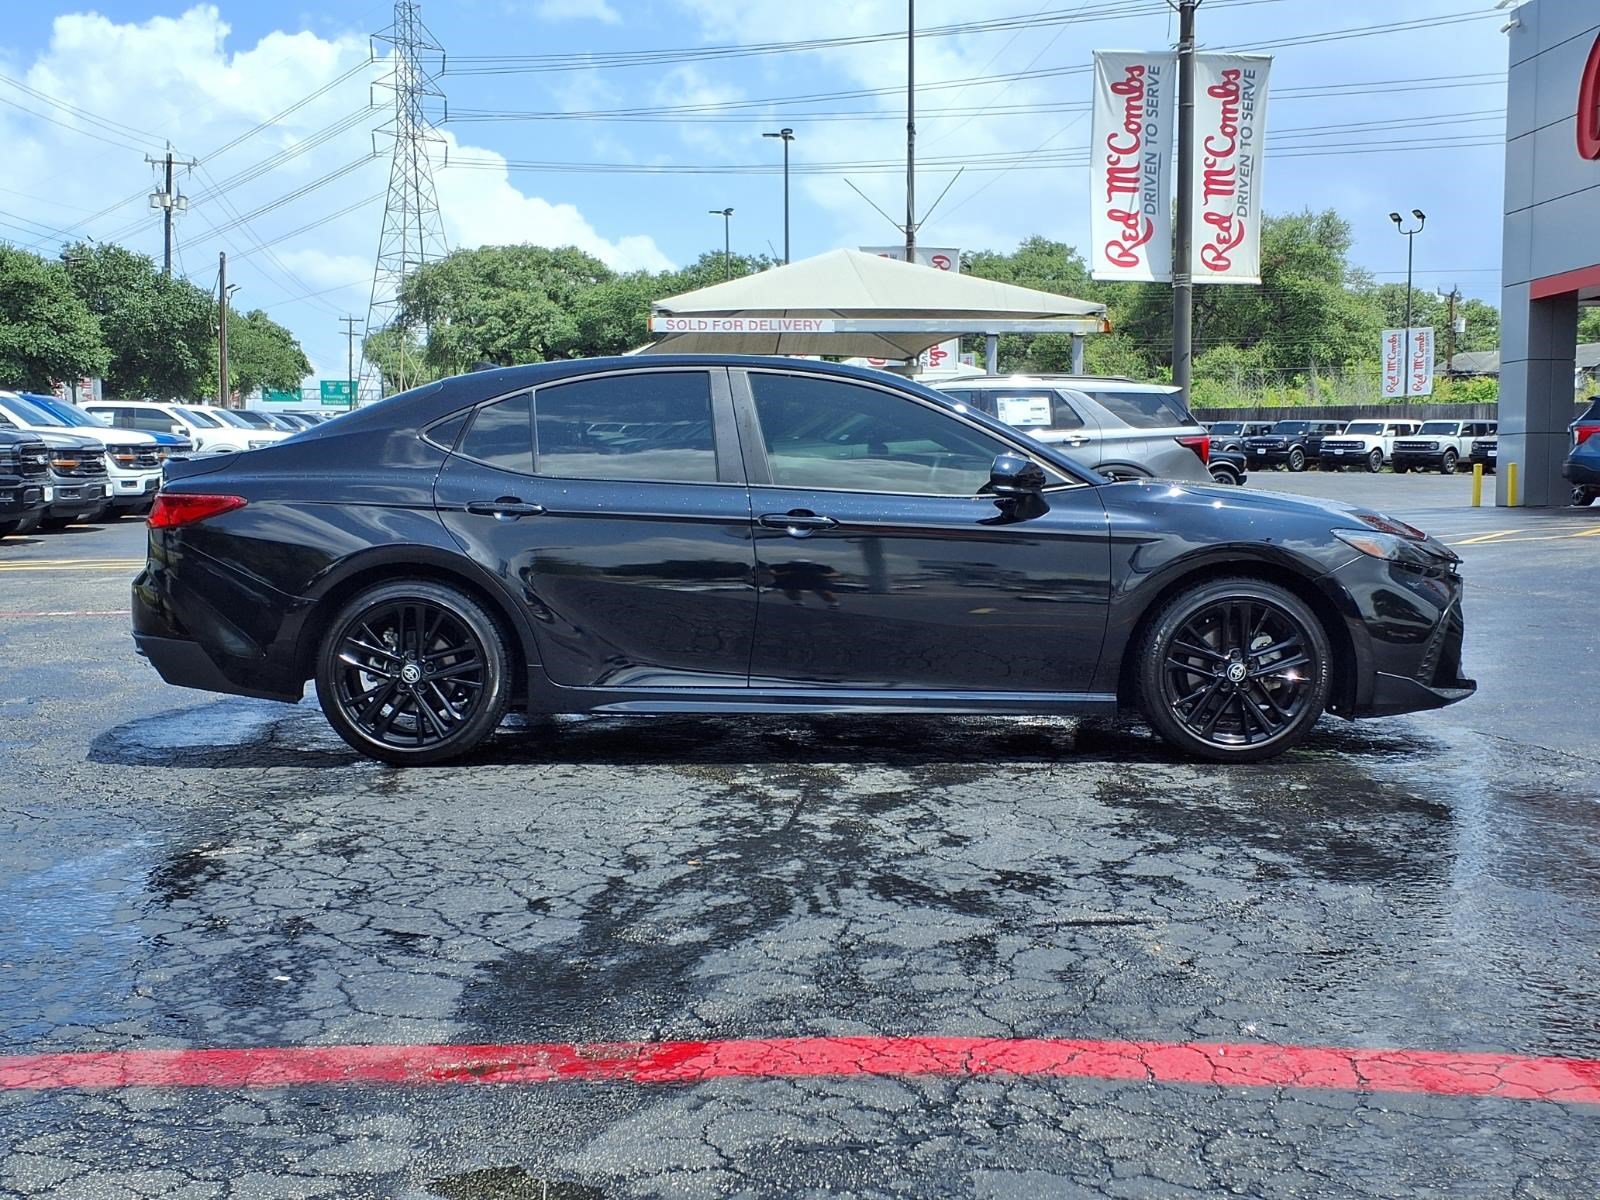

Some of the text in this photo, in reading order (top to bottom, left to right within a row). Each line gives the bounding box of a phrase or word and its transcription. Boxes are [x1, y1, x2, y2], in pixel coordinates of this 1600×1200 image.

[1105, 65, 1154, 268] Red McCombs
[1144, 65, 1161, 215] DRIVEN TO SERVE
[1200, 68, 1245, 272] Red McCombs
[1237, 68, 1256, 218] DRIVEN TO SERVE
[666, 319, 823, 331] SOLD FOR DELIVERY
[1386, 334, 1399, 393] Red McCombs
[1412, 332, 1427, 391] Red McCombs
